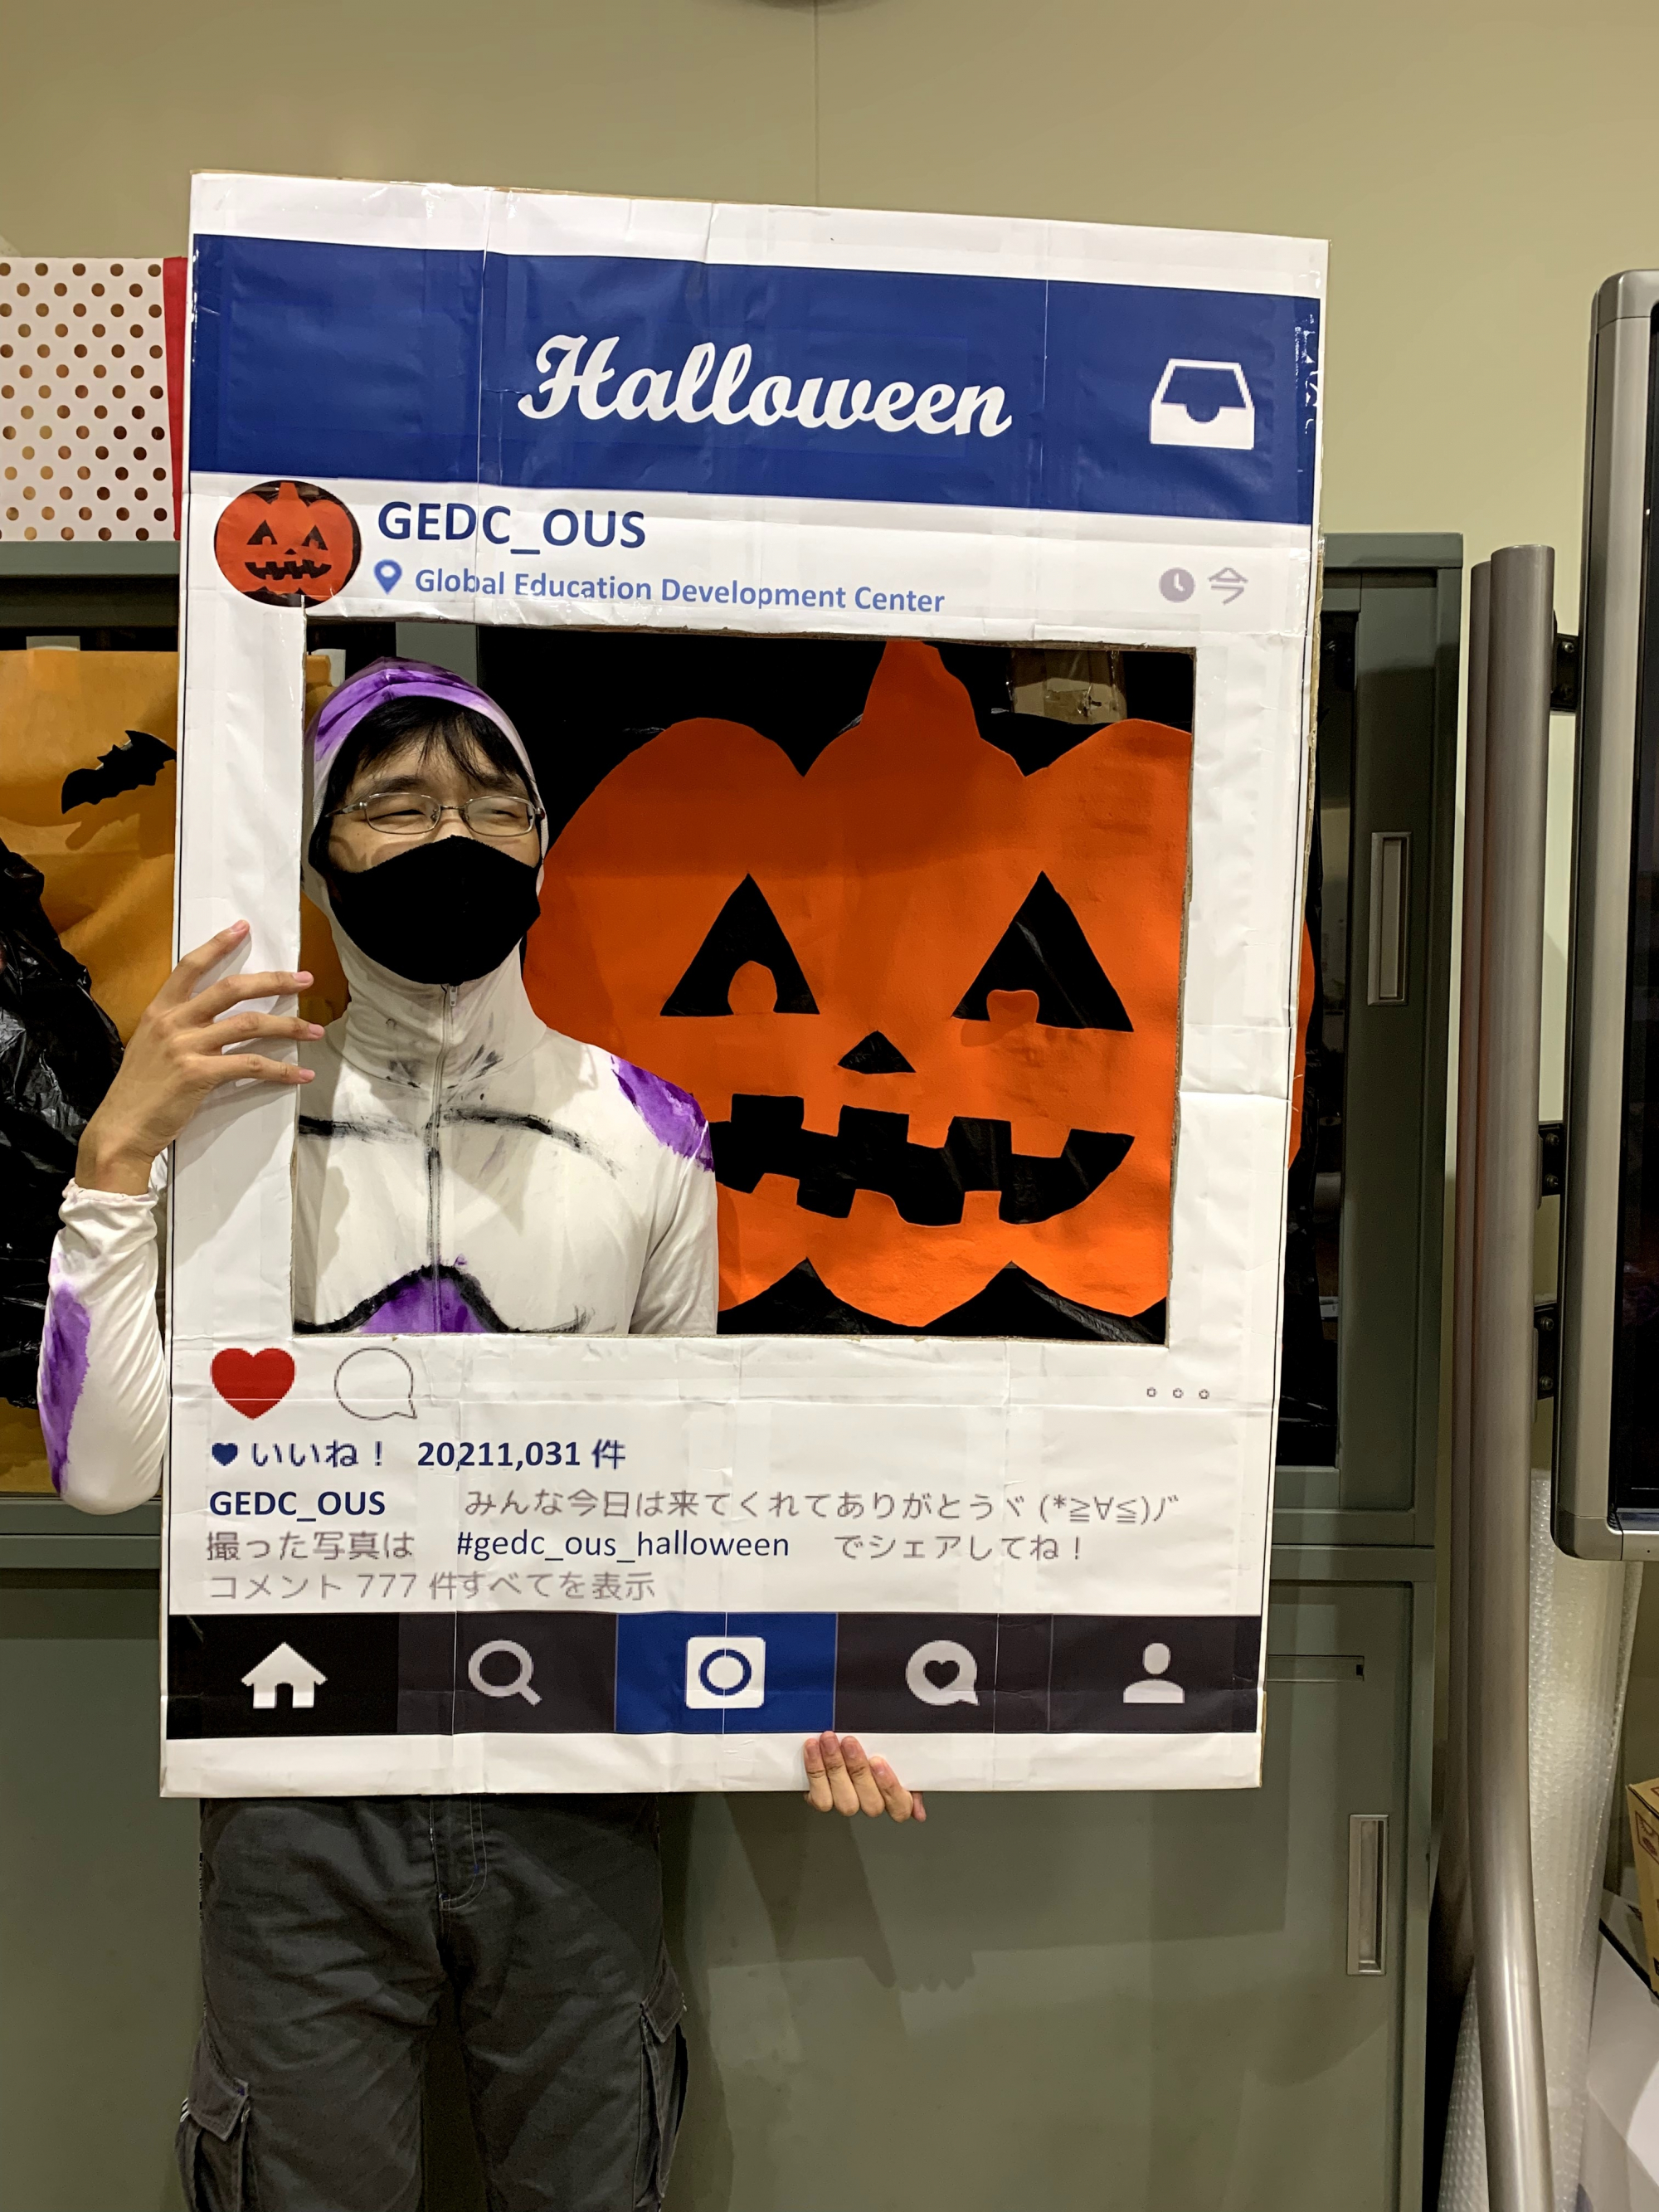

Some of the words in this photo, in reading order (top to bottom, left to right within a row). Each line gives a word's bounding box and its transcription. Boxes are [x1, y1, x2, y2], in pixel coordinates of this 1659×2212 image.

[518, 334, 1013, 437] Halloween
[378, 501, 646, 555] GEDC_OUS
[416, 568, 504, 595] Global
[514, 572, 652, 601] Education
[661, 578, 847, 611] Development
[854, 586, 946, 613] Center
[591, 1438, 626, 1470] 件
[209, 1491, 386, 1522] GEDC_OUS
[207, 1531, 416, 1561] 撮った写真は
[457, 1529, 790, 1563] #gedc_ous_halloween
[357, 1573, 417, 1599] 777
